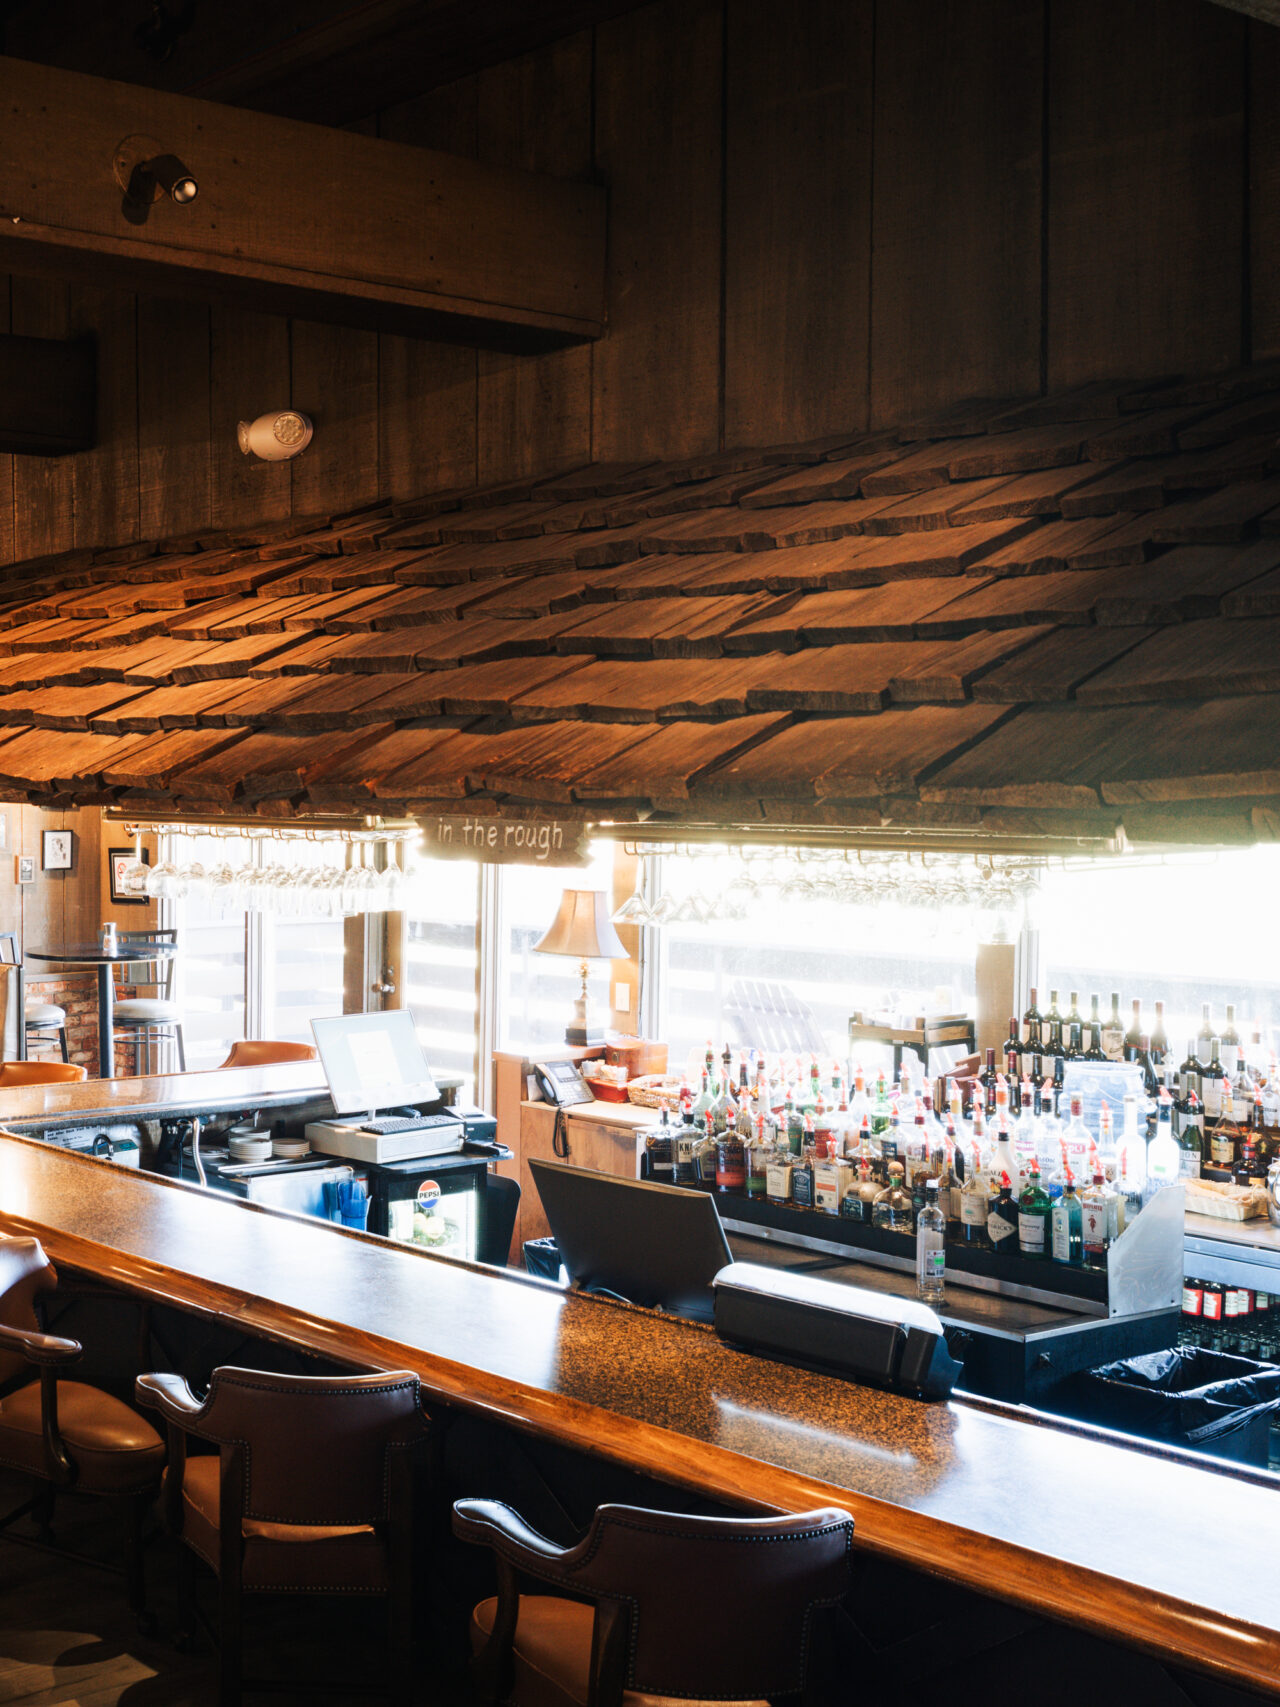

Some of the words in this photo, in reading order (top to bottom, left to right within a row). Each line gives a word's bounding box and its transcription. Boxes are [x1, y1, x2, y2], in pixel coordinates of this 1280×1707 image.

[438, 817, 453, 843] in
[463, 818, 498, 848] the
[504, 821, 564, 860] rough
[419, 1190, 440, 1199] PEPSI
